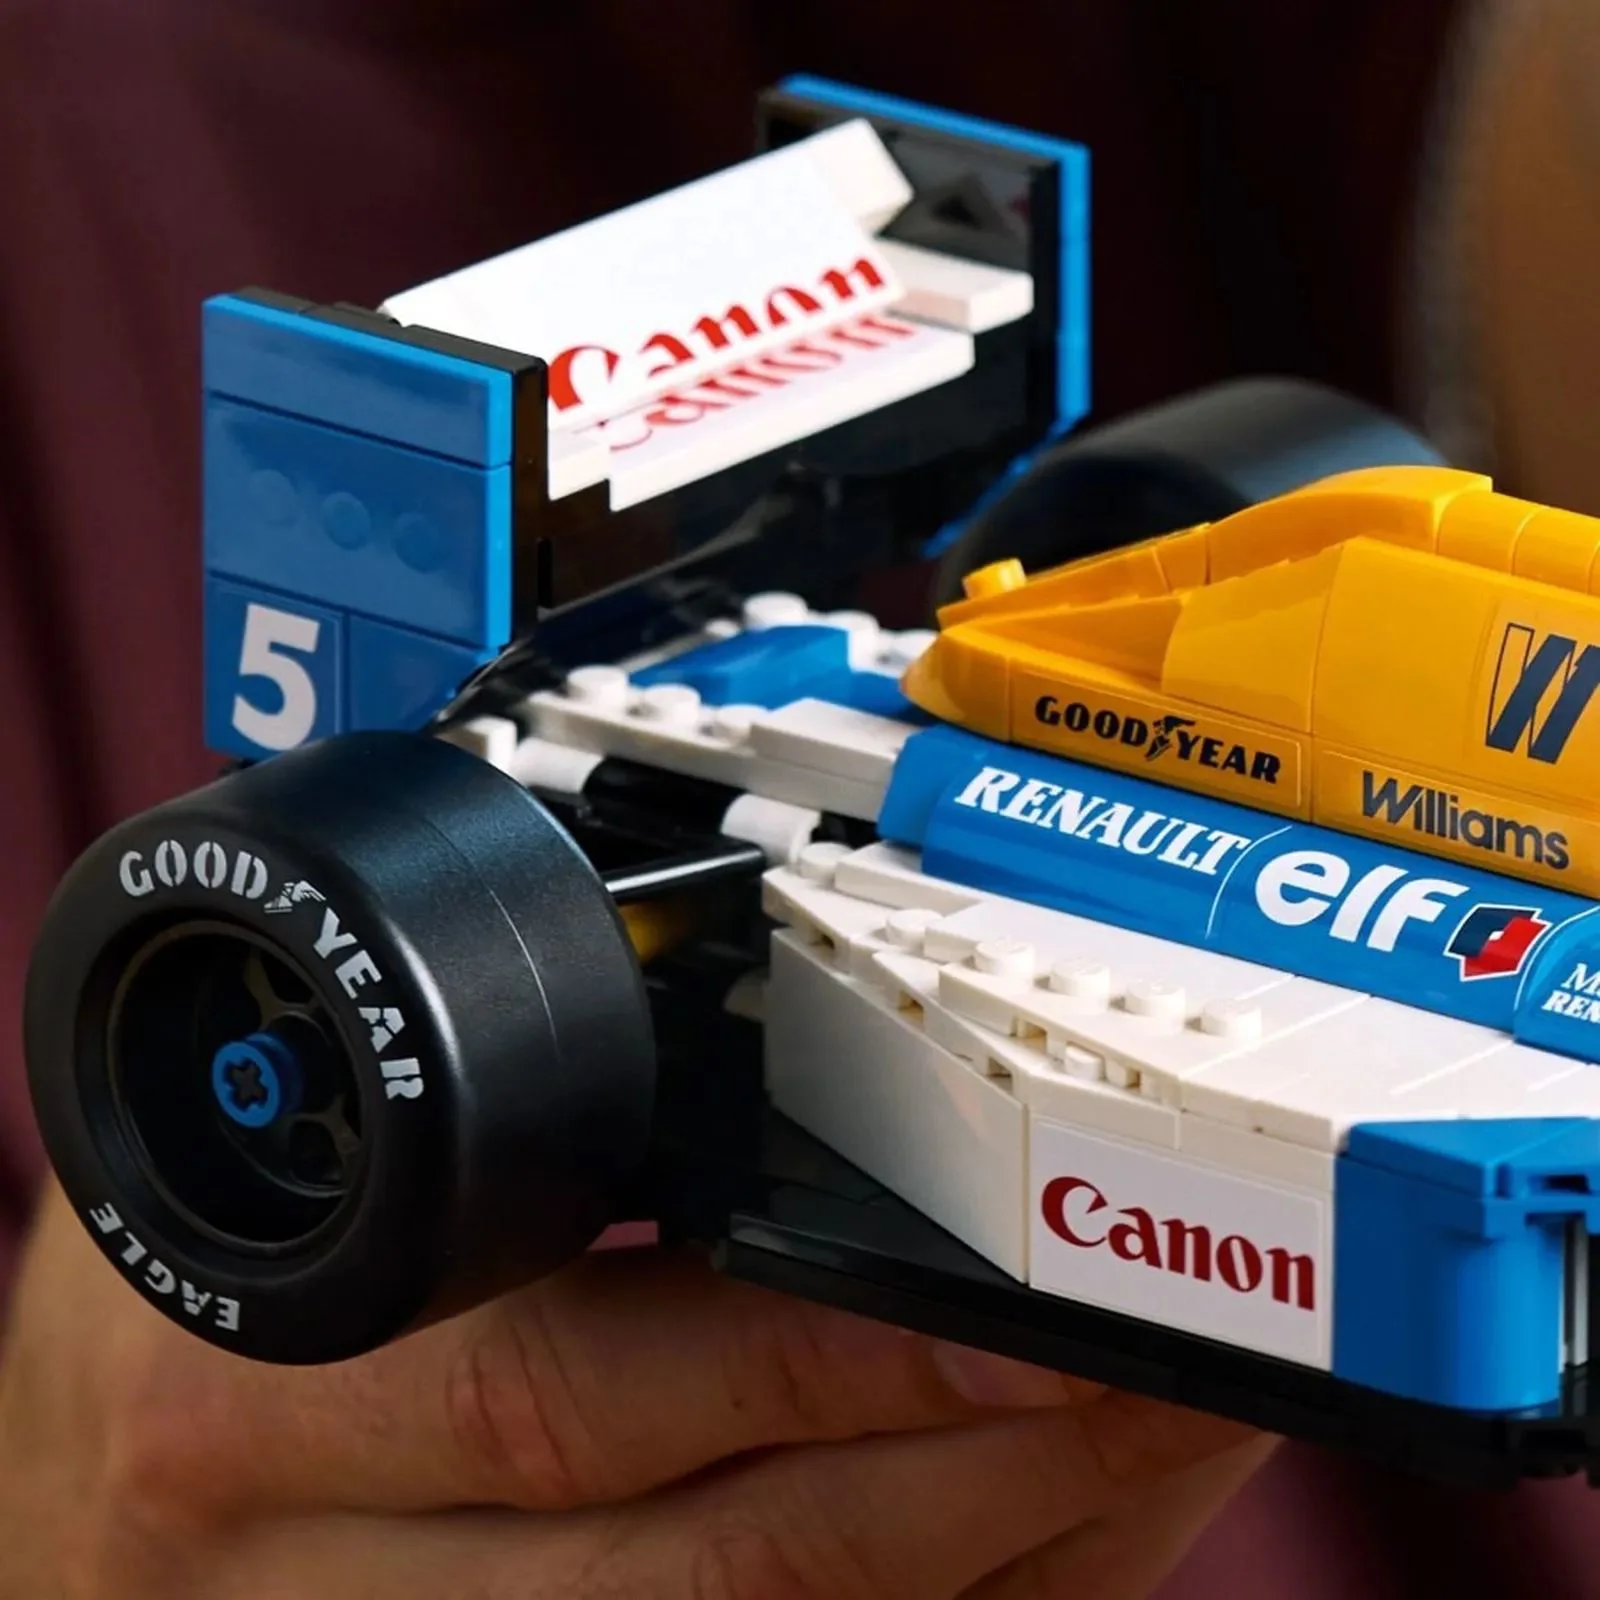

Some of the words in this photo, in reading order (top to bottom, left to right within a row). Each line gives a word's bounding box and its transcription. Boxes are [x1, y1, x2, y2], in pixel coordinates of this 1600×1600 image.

[548, 257, 914, 453] Canon
[232, 603, 320, 752] 5
[955, 766, 1251, 876] RENAULT
[1363, 770, 1570, 870] Williams
[1255, 850, 1470, 952] elf
[89, 1203, 241, 1331] EAGLE
[1041, 1176, 1315, 1311] Canon
